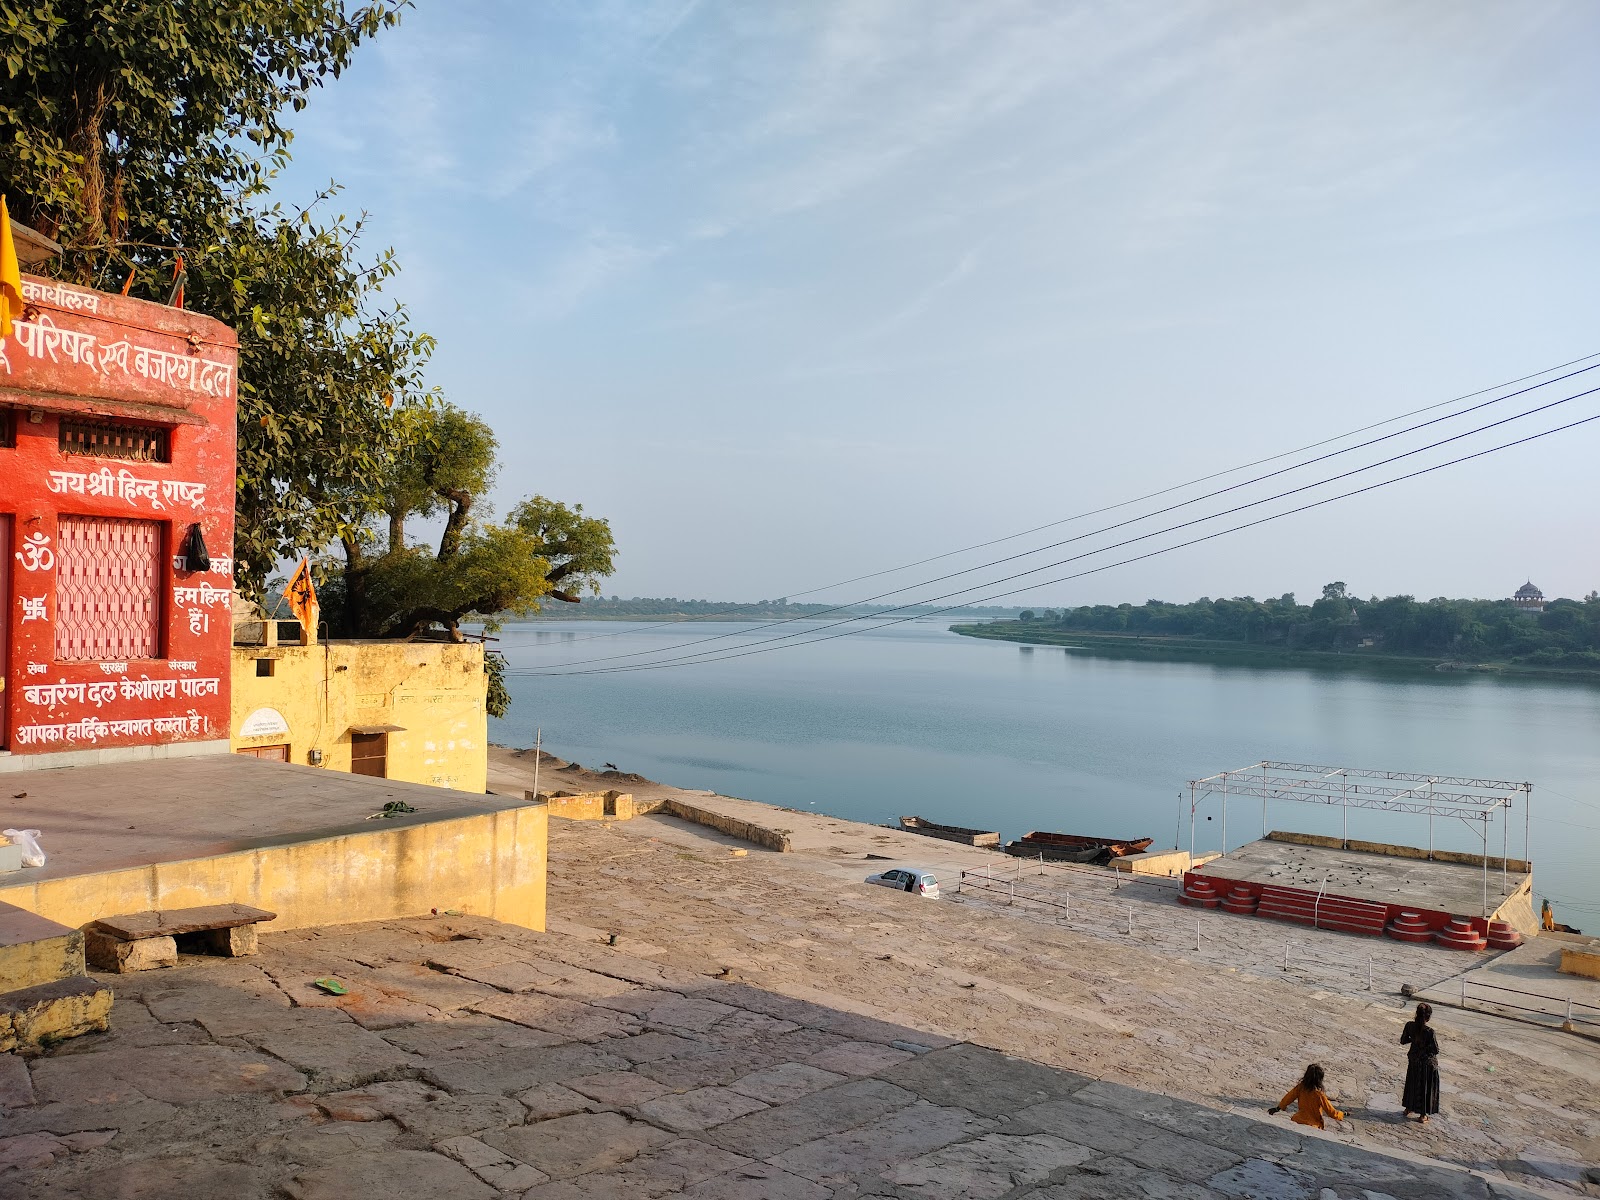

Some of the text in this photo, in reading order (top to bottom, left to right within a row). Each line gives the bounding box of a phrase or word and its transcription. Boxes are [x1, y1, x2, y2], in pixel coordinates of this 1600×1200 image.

[11, 314, 98, 373] परिषद
[134, 345, 200, 391] बजरंग
[201, 358, 233, 398] दल
[45, 467, 207, 511] जय श्री हिन्दू राष्ट्र
[173, 586, 199, 608] हम
[27, 659, 197, 675] सेवा सुरक्षा संस्कार
[23, 674, 220, 708] बजरंग दल केशोराय पाटन
[16, 724, 67, 744] आपका
[66, 716, 109, 744] हार्दिक
[108, 719, 154, 737] स्वागत
